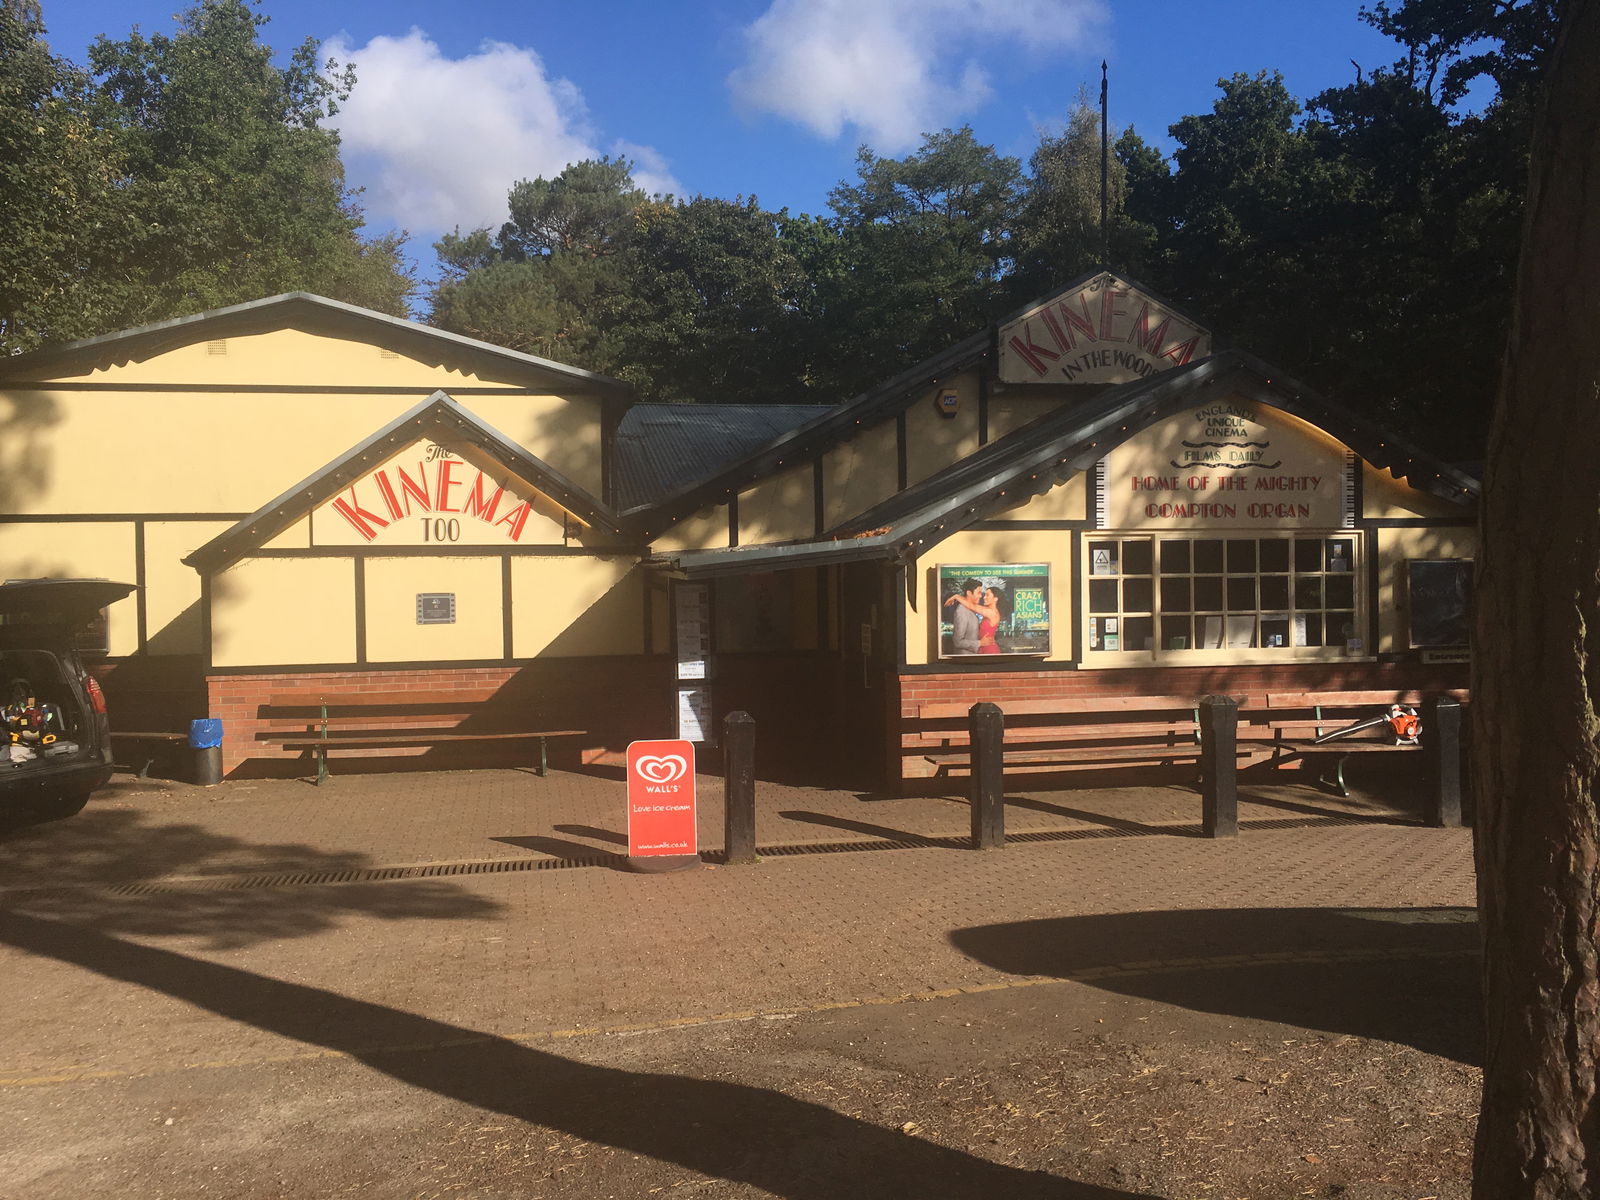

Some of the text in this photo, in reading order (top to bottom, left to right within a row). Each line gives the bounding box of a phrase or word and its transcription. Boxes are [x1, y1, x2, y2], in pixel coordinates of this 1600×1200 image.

[1008, 290, 1200, 377] KINEMA
[1061, 358, 1083, 381] IN
[1081, 348, 1111, 369] THE
[1207, 417, 1245, 427] UNIQUE
[1205, 428, 1248, 437] CINEMA
[425, 444, 454, 463] The
[1184, 450, 1265, 462] FILMS DAILY
[1131, 475, 1322, 491] HOME OF THE MIGHTY
[331, 459, 538, 543] KINEMA
[1145, 503, 1310, 518] COMPTON ORGAN
[420, 517, 460, 542] TOO
[1015, 591, 1041, 600] CRAZY
[1015, 600, 1041, 611] RICH
[1015, 611, 1042, 619] ASIANS
[646, 785, 679, 793] WALL'S
[633, 804, 651, 812] Love
[652, 804, 665, 812] ice
